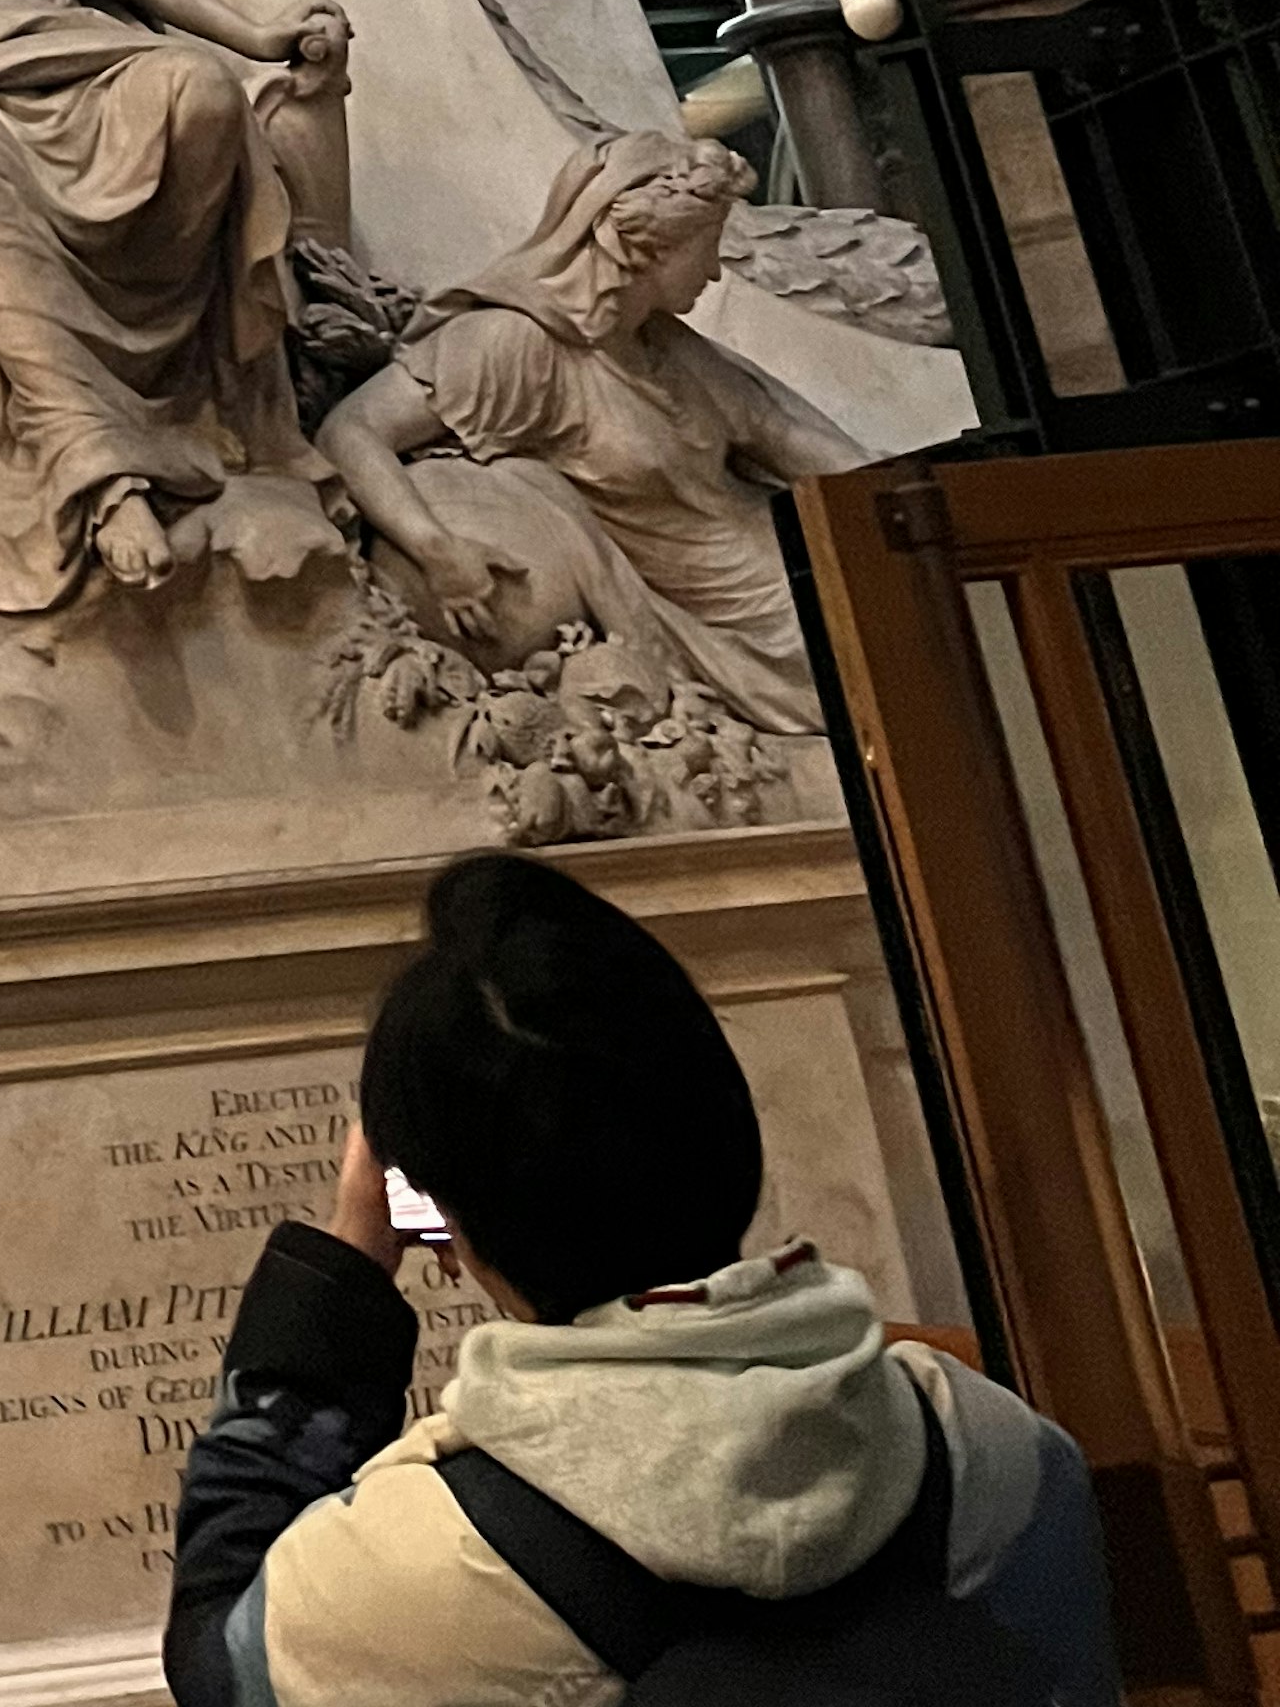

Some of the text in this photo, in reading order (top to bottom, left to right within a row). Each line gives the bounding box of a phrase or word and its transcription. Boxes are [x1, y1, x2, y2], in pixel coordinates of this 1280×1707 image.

[211, 1084, 341, 1118] ERECTED
[102, 1141, 163, 1167] THE
[174, 1124, 250, 1160] KING
[258, 1123, 317, 1150] AND
[168, 1179, 200, 1198] AS
[213, 1173, 231, 1196] A
[126, 1200, 317, 1241] THE VIRTUES
[89, 1337, 200, 1374] DURING
[96, 1384, 134, 1411] OF
[45, 1520, 86, 1545] TO
[101, 1514, 135, 1538] AN
